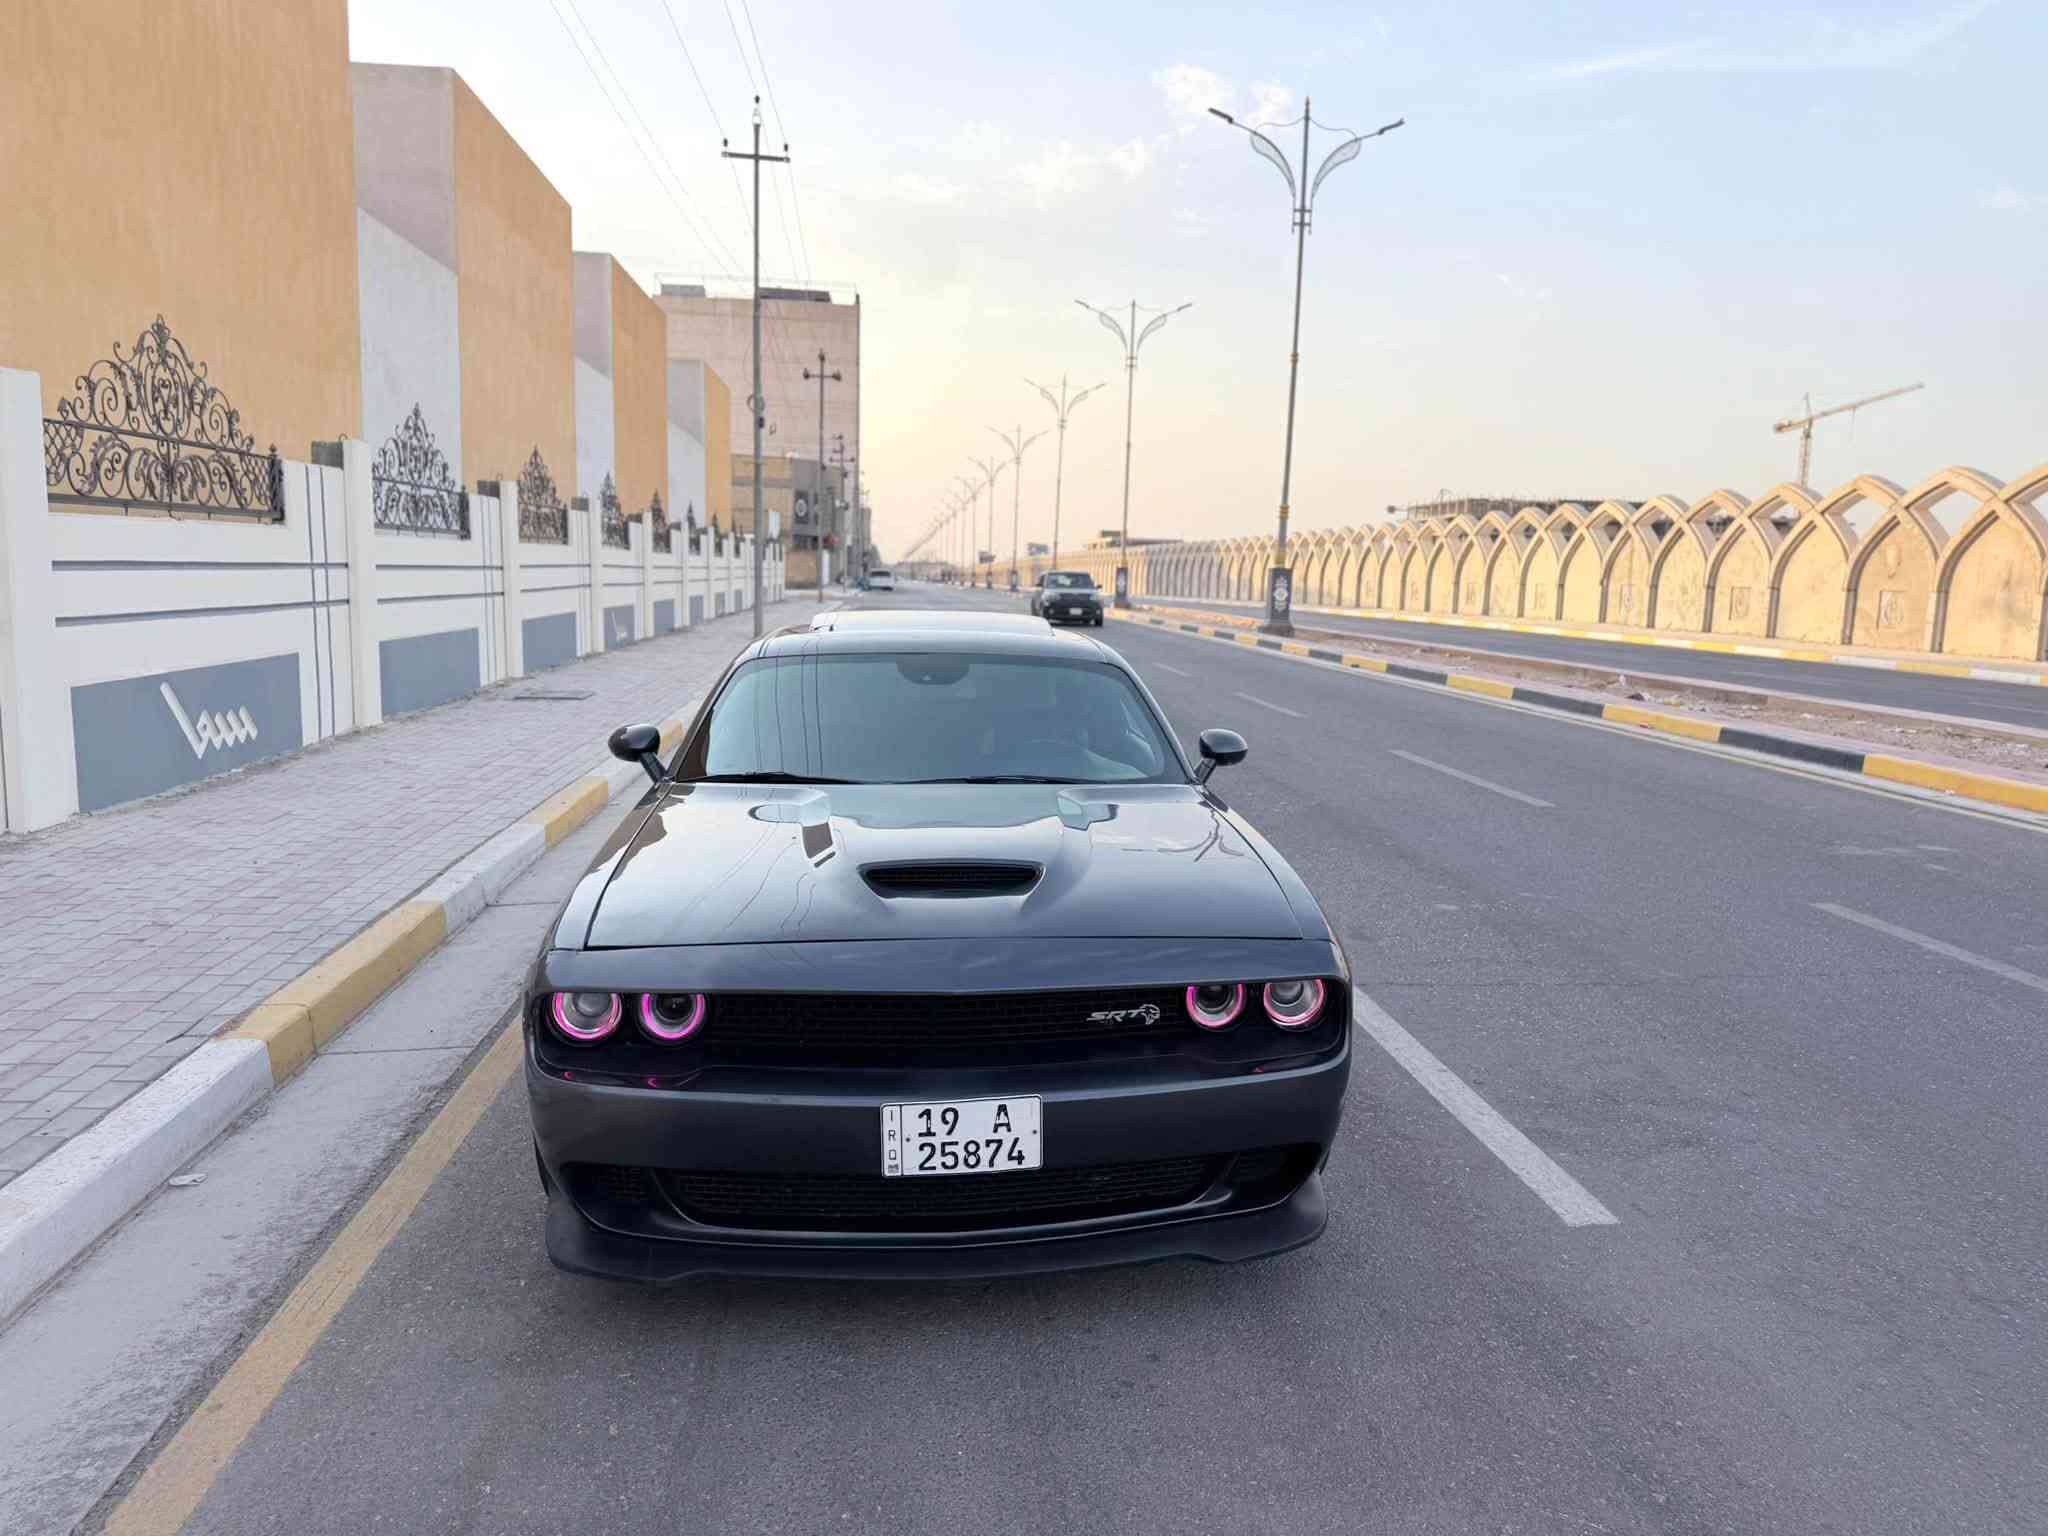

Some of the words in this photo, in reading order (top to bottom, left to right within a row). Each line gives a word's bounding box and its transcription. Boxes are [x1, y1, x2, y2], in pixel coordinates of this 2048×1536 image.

[1086, 1009, 1144, 1022] SRT
[917, 1107, 960, 1137] 19
[992, 1104, 1012, 1134] A
[918, 1137, 1025, 1171] 25874
